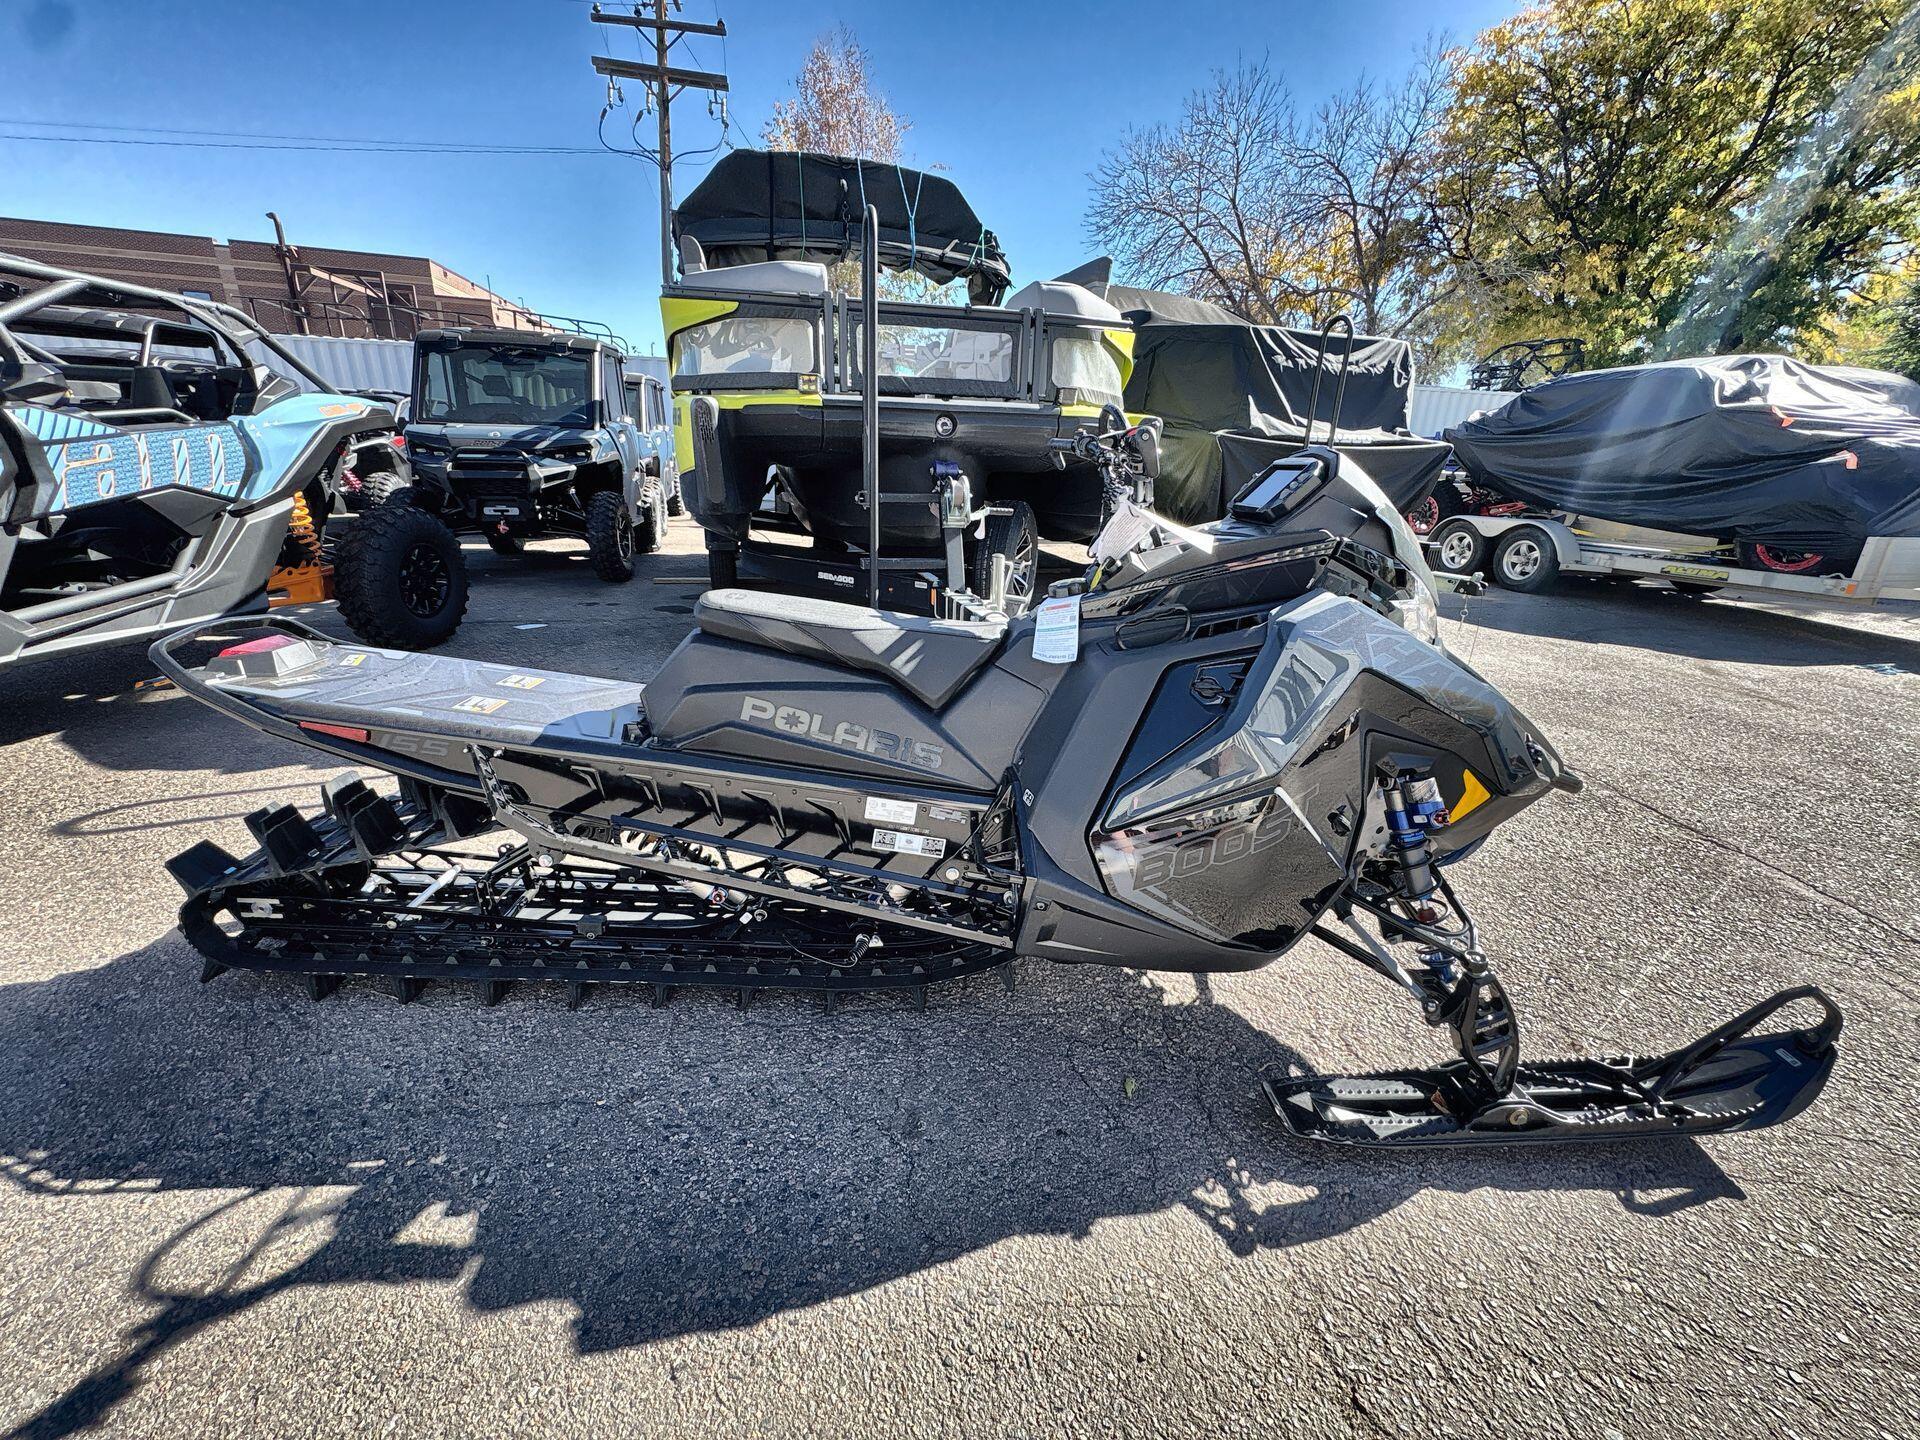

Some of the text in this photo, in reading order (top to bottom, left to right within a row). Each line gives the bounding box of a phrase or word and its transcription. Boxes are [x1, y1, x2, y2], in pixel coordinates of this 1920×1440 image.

[1663, 565, 1729, 580] ALUMA
[740, 696, 944, 769] POLARIS
[380, 733, 449, 757] 155
[1133, 783, 1320, 890] BOOST
[1475, 1018, 1509, 1034] POLARIS
